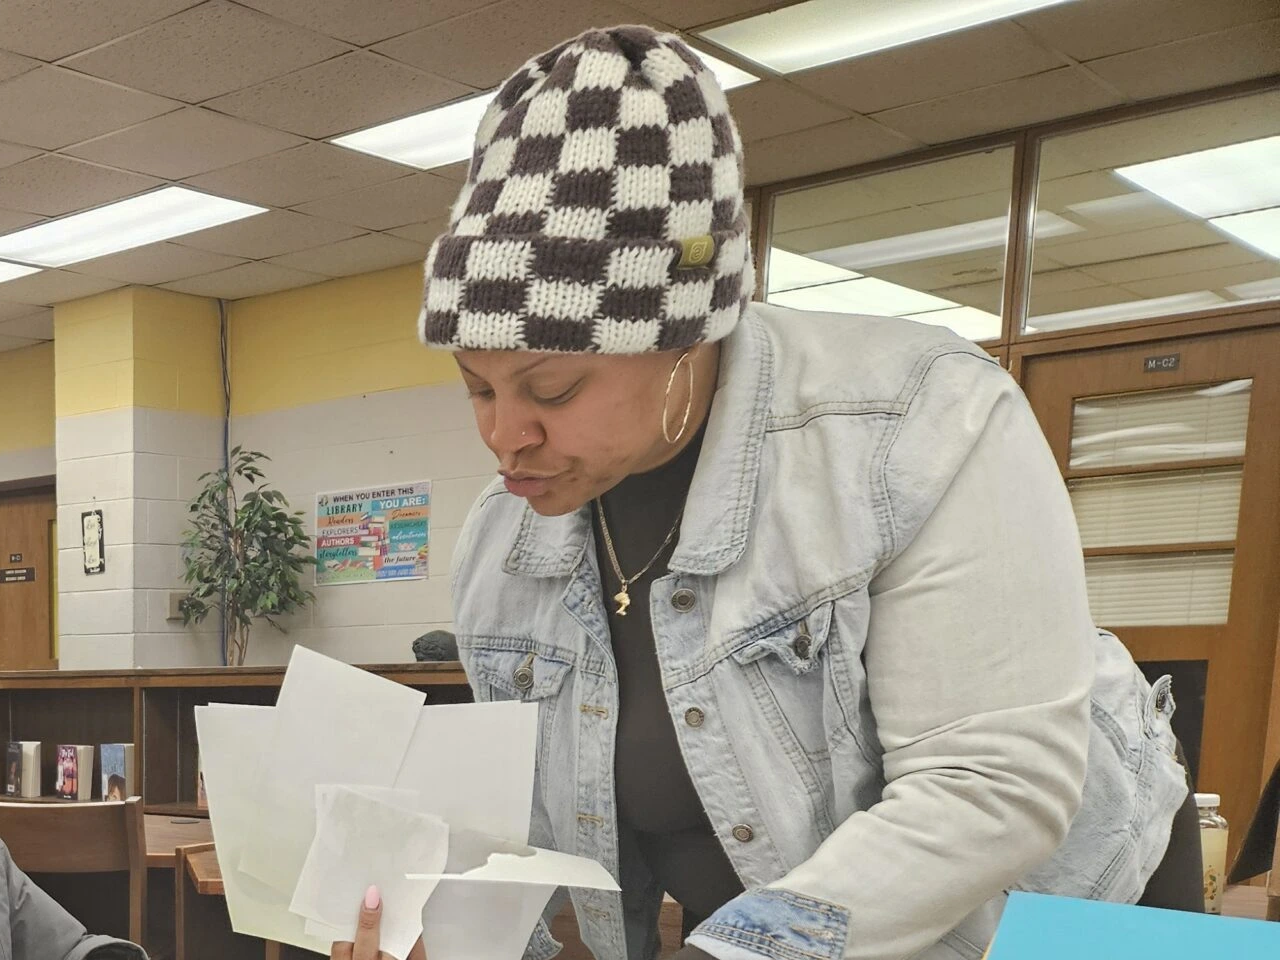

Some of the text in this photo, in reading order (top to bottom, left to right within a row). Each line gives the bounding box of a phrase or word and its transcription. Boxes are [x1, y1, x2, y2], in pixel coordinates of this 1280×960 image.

[1148, 357, 1175, 369] M-C2
[333, 487, 414, 503] WHEN YOU ENTER THIS
[327, 503, 363, 515] LIBRARY
[379, 496, 426, 510] YOU ARE:
[323, 526, 359, 537] EXPLORERS
[321, 537, 355, 547] AUTHORS
